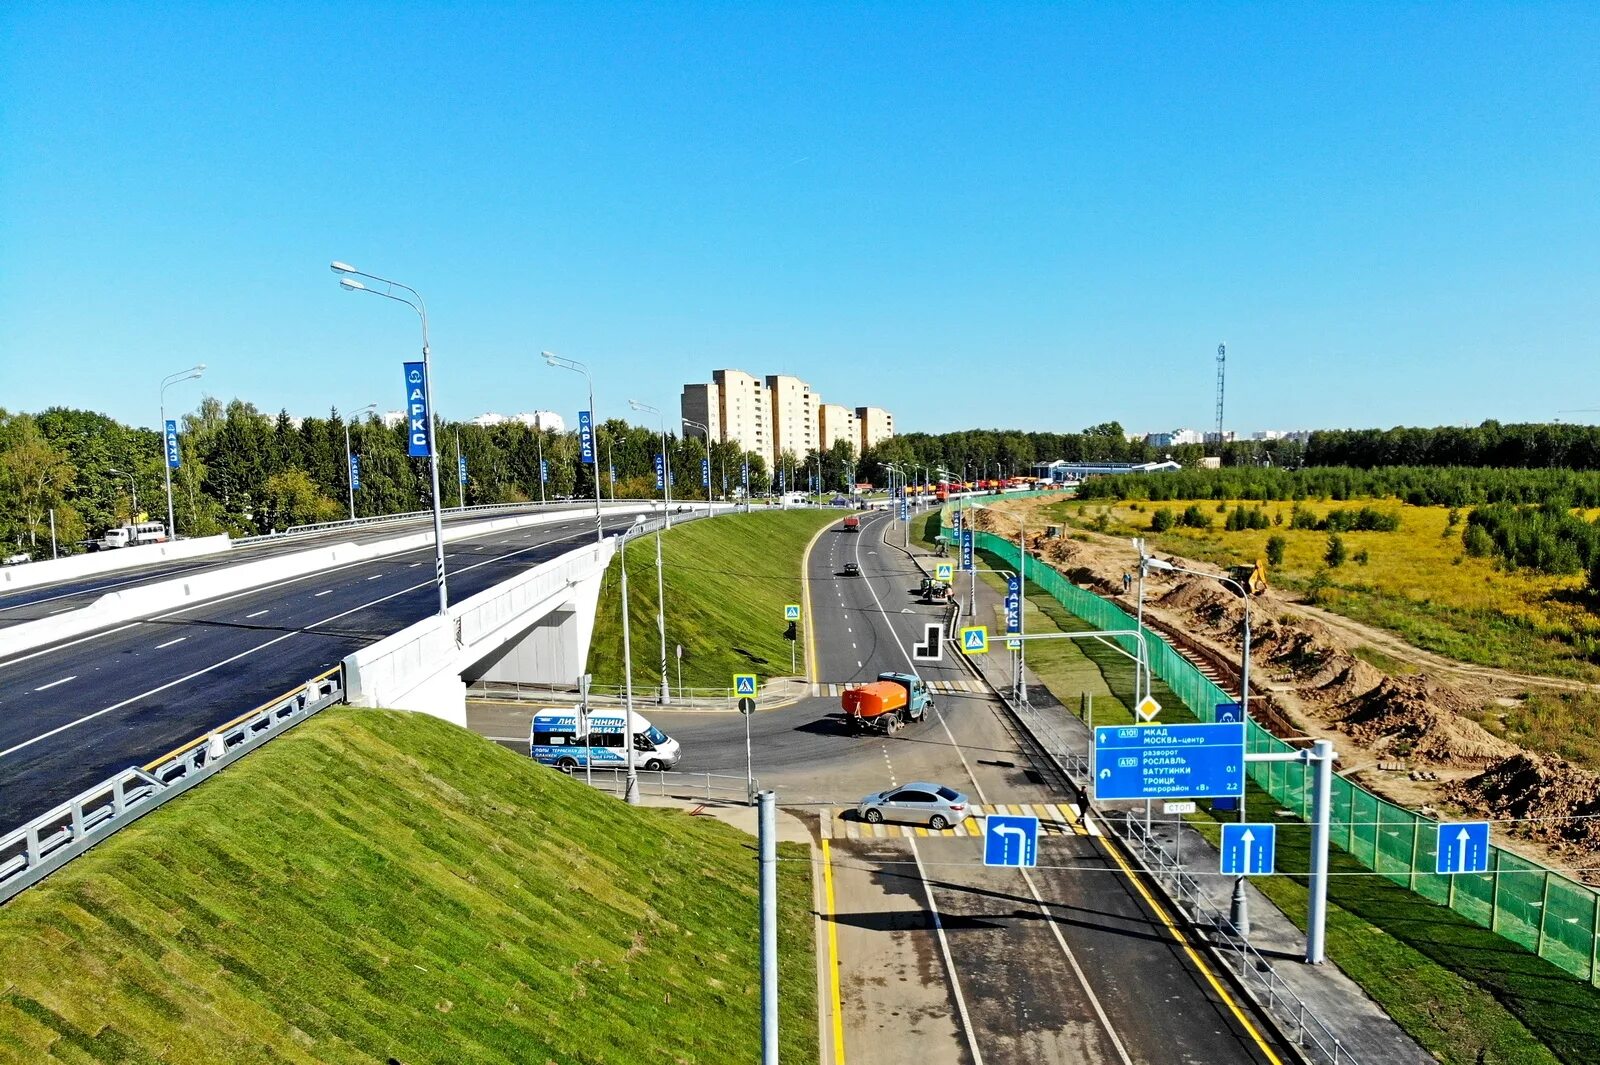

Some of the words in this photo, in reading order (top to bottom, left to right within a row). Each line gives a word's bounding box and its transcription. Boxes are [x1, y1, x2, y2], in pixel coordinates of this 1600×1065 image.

[410, 388, 426, 445] АРКС
[581, 426, 592, 457] АРКС
[1009, 594, 1019, 627] АРКС
[557, 718, 627, 726] ЛИСЕННИЦА
[1143, 767, 1191, 775] ВАТУТИНКИ
[1143, 777, 1175, 785] ТРОИЦК
[1143, 785, 1189, 793] микрорайон
[1168, 804, 1191, 812] СТОП
